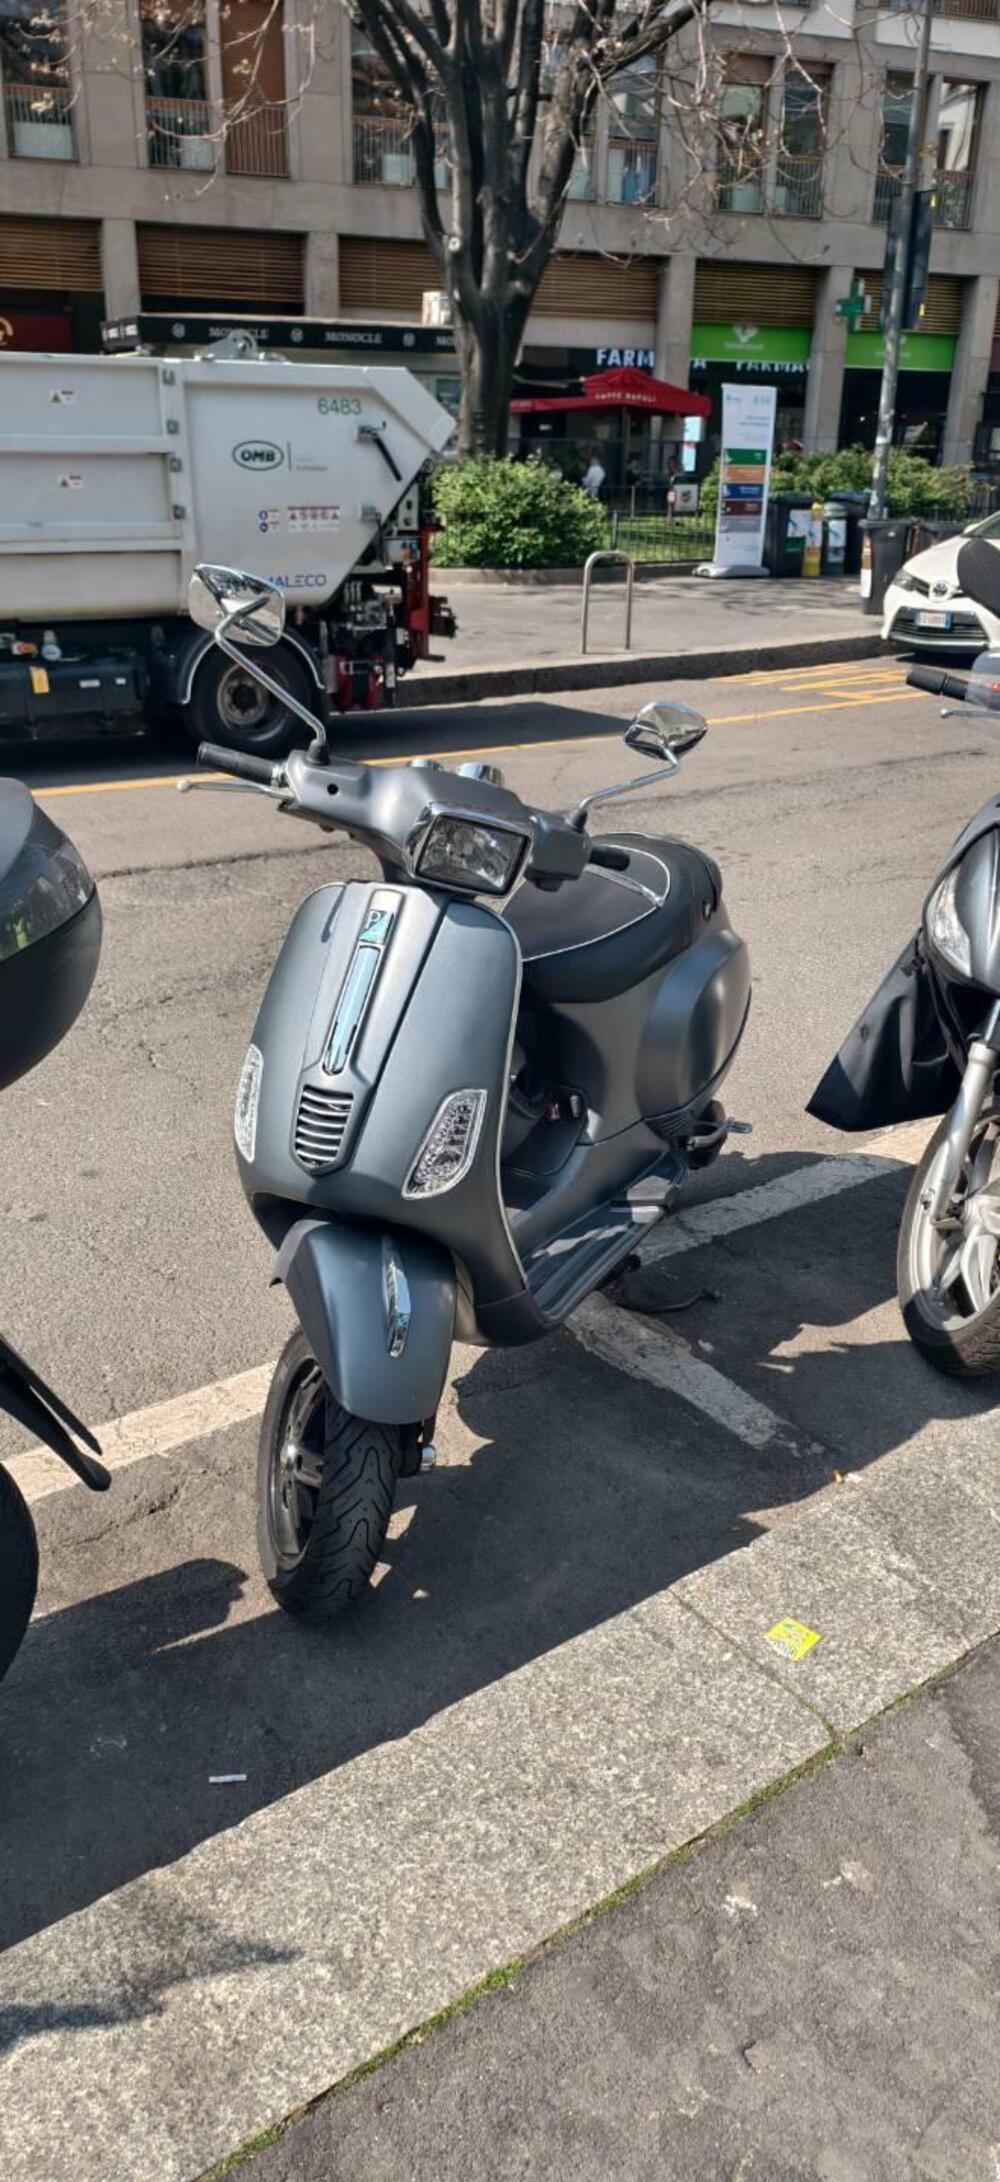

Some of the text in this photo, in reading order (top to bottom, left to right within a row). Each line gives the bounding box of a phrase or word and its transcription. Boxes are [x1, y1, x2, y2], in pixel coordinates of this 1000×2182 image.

[324, 331, 382, 344] MONOCLE
[317, 398, 362, 415] 6483
[240, 449, 276, 462] OMB
